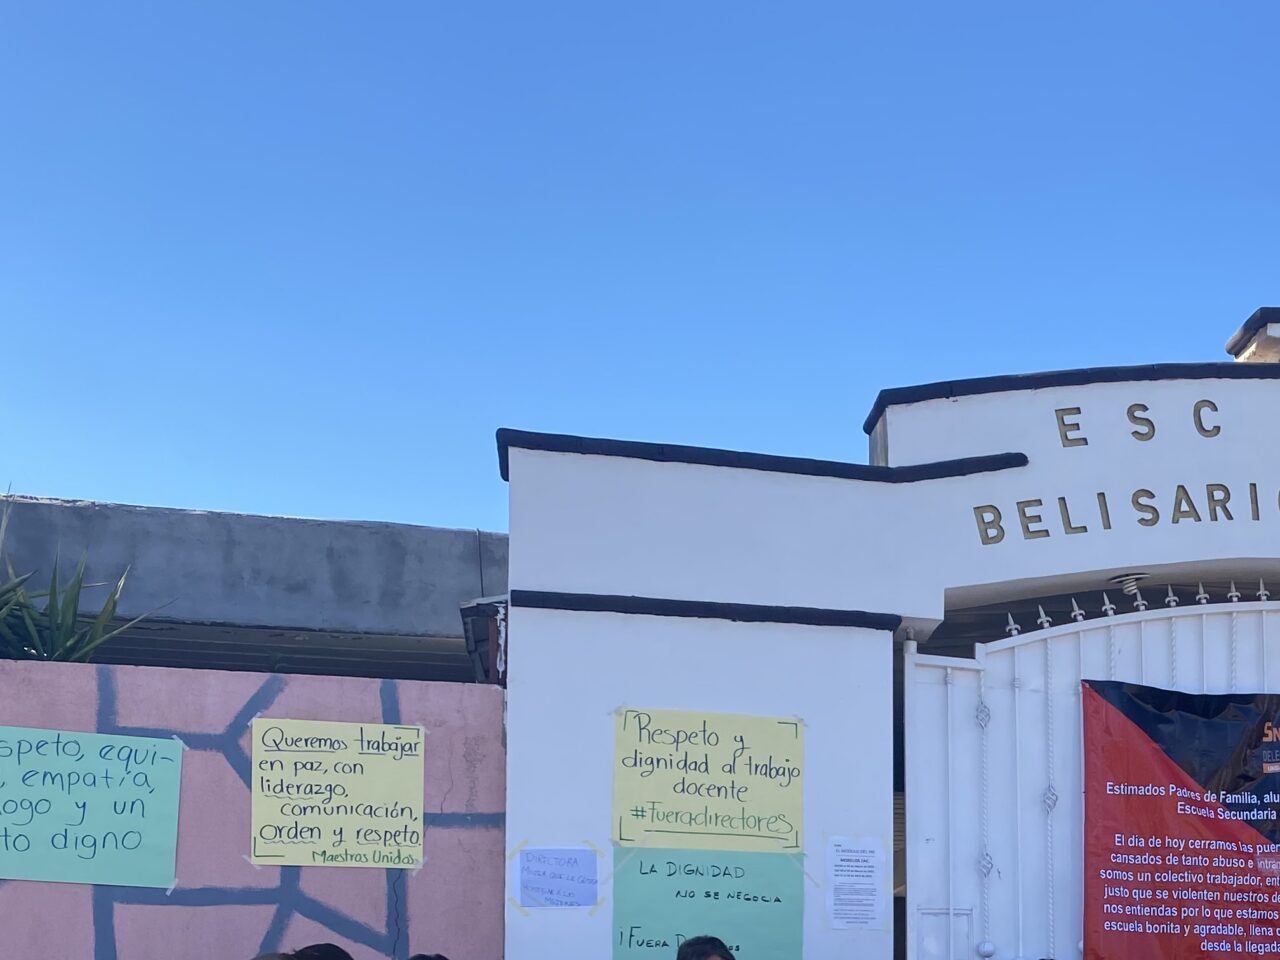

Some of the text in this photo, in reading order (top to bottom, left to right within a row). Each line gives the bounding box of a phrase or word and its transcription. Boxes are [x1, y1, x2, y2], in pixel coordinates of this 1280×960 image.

[1054, 400, 1221, 448] ESC
[262, 726, 421, 755] Queremos trabajar
[636, 712, 750, 756] Respeto y
[0, 733, 84, 765] speto,
[259, 758, 364, 776] en paz, con
[622, 750, 800, 787] dignidad al trabajo
[22, 769, 155, 795] empatía,
[260, 778, 349, 798] liderazgo,
[673, 777, 748, 802] docente
[1106, 782, 1165, 796] Estimados
[1169, 784, 1200, 801] Padres
[1204, 790, 1217, 801] de
[1220, 791, 1260, 805] Familia,
[64, 802, 86, 826] y
[114, 799, 145, 818] un
[280, 800, 418, 822] comunicación,
[1177, 802, 1214, 819] Escuela
[1218, 808, 1276, 821] Secundaria
[51, 828, 141, 859] digno
[333, 827, 345, 845] y
[1115, 834, 1125, 846] El
[1149, 836, 1161, 848] de
[1166, 836, 1185, 851] hoy
[1189, 839, 1237, 851] cerramos
[1239, 839, 1253, 852] las
[312, 850, 415, 864] Maestros Unidos
[1111, 852, 1162, 865] cansados
[1166, 853, 1178, 866] de
[1182, 853, 1209, 867] tanto
[1213, 855, 1244, 868] abuso
[1248, 859, 1253, 868] e
[640, 861, 745, 878] LA DIGNIDAD
[1100, 870, 1133, 881] somos
[1138, 872, 1151, 882] un
[1155, 871, 1204, 883] colectivo
[1207, 873, 1263, 887] trabajador,
[675, 890, 782, 903] NO SE NEGOCIA
[1201, 940, 1231, 951] desde
[1234, 940, 1242, 952] la
